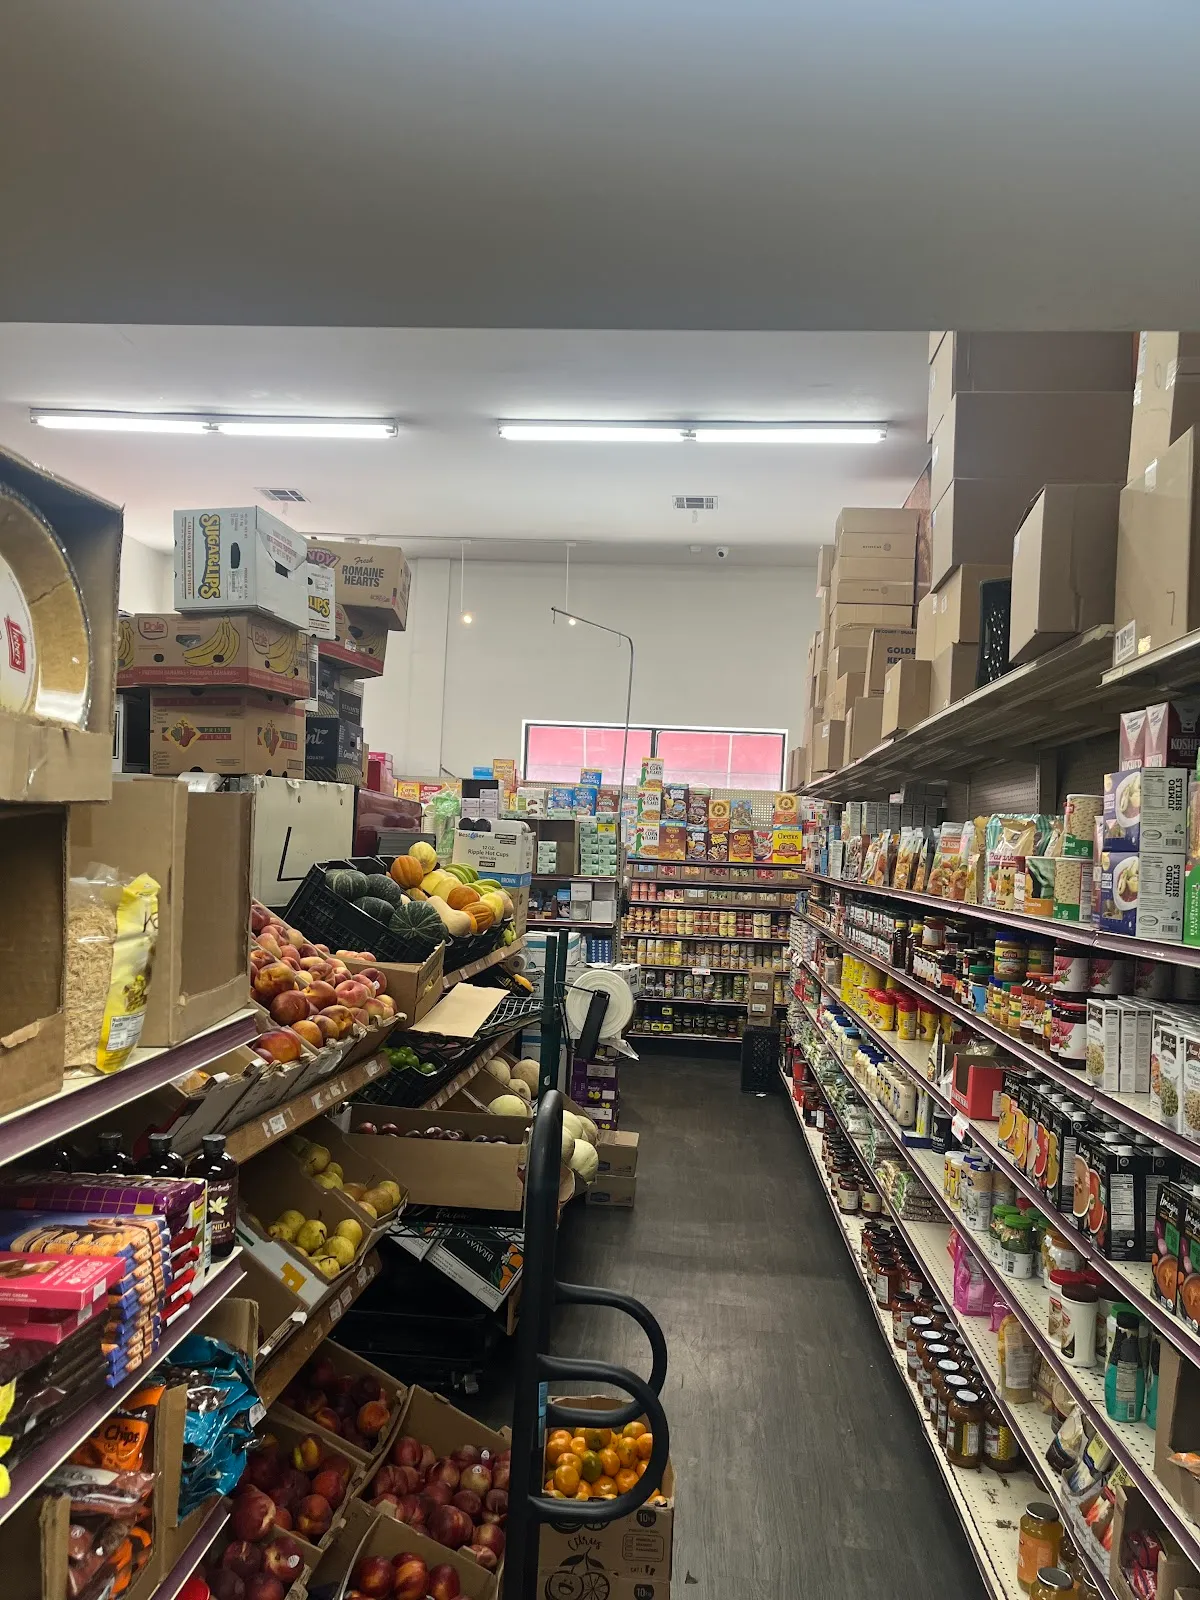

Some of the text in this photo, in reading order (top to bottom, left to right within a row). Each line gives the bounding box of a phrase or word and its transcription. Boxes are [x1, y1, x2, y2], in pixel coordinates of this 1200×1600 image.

[307, 550, 337, 566] NDY
[354, 556, 375, 565] Fresh
[341, 565, 385, 579] ROMAINE
[344, 575, 380, 588] HEARTS
[308, 595, 331, 618] LIPS
[143, 621, 165, 631] Dole
[887, 646, 916, 655] GOLDE
[1168, 779, 1176, 811] JUMBO
[1175, 778, 1183, 811] SHELLS
[1165, 865, 1173, 898] JUMBO
[1172, 864, 1181, 898] SHELLS
[211, 1221, 231, 1231] NILLA
[637, 1587, 646, 1595] 10
